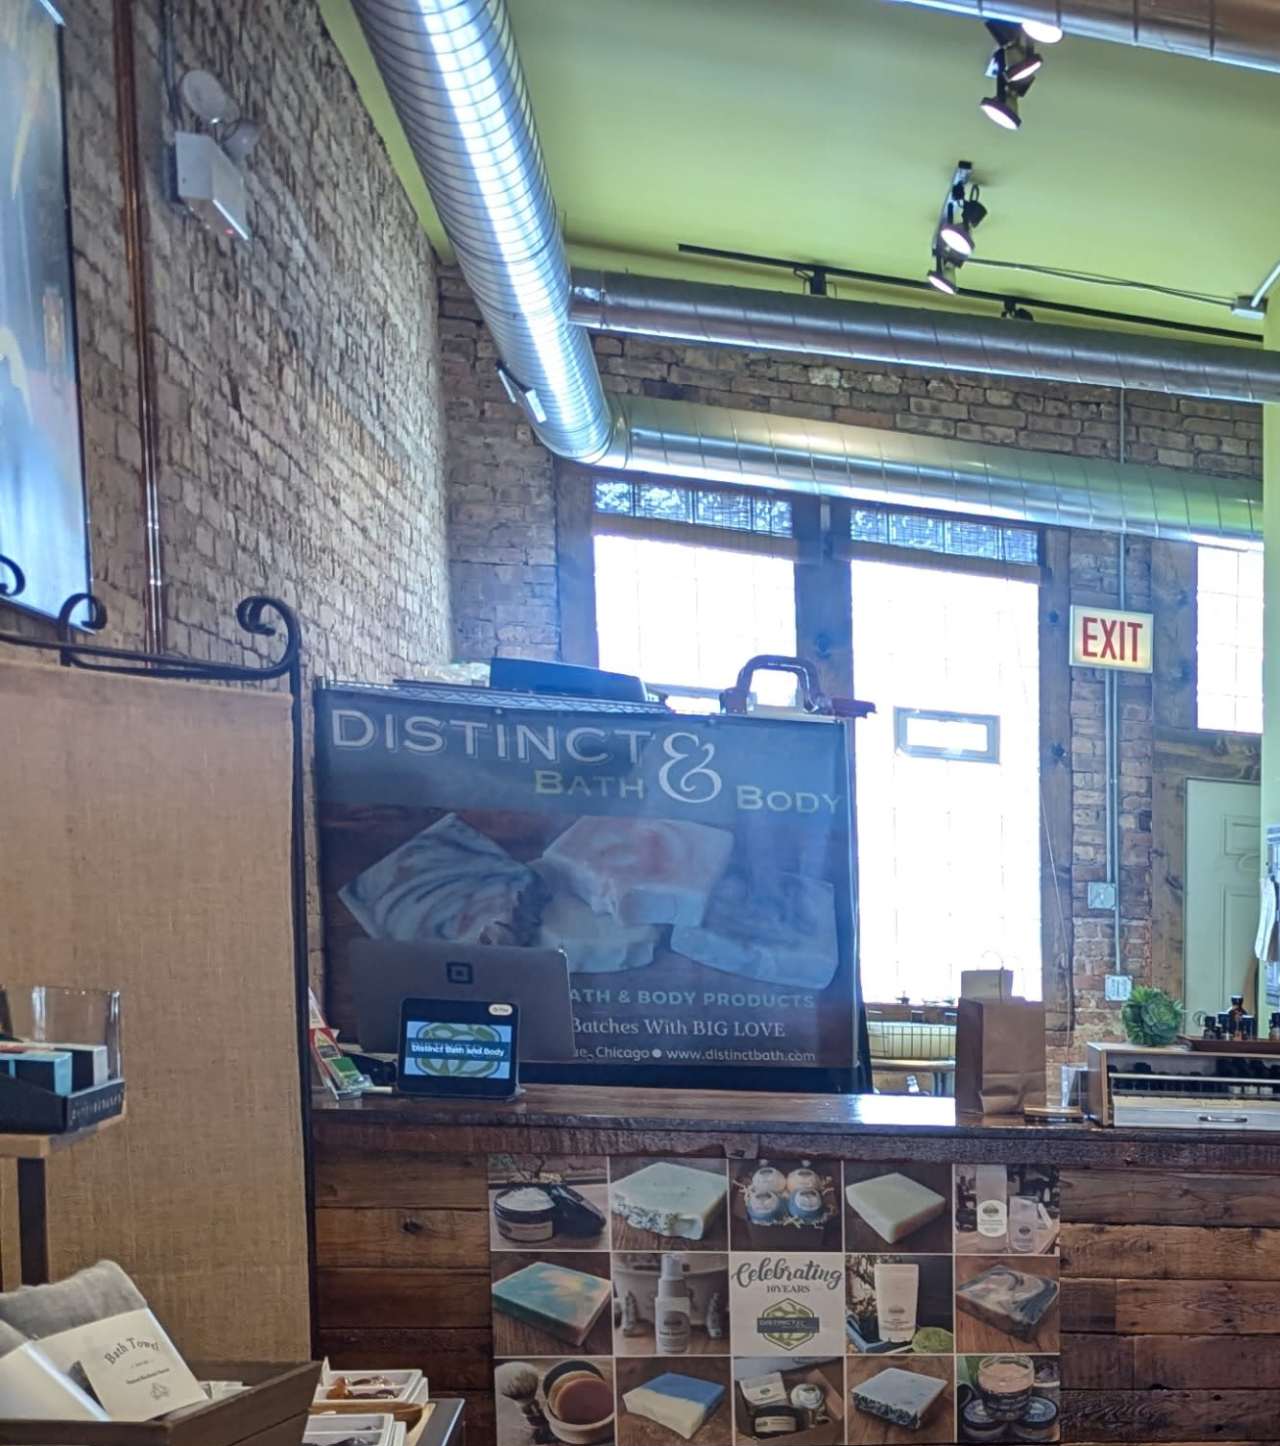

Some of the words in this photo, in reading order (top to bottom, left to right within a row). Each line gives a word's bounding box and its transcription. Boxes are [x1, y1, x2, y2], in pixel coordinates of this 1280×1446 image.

[1082, 616, 1143, 662] EXIT
[331, 709, 655, 766] DISTINCT
[569, 988, 611, 1004] ATH
[618, 989, 631, 1005] &
[637, 990, 697, 1006] BODY
[703, 991, 816, 1009] PRODUCTS
[573, 1017, 640, 1035] Batches
[644, 1018, 688, 1036] With
[693, 1020, 729, 1037] BIG
[734, 1021, 787, 1038] LOVE
[595, 1045, 650, 1062] Chicago
[731, 1257, 842, 1291] Celebrating
